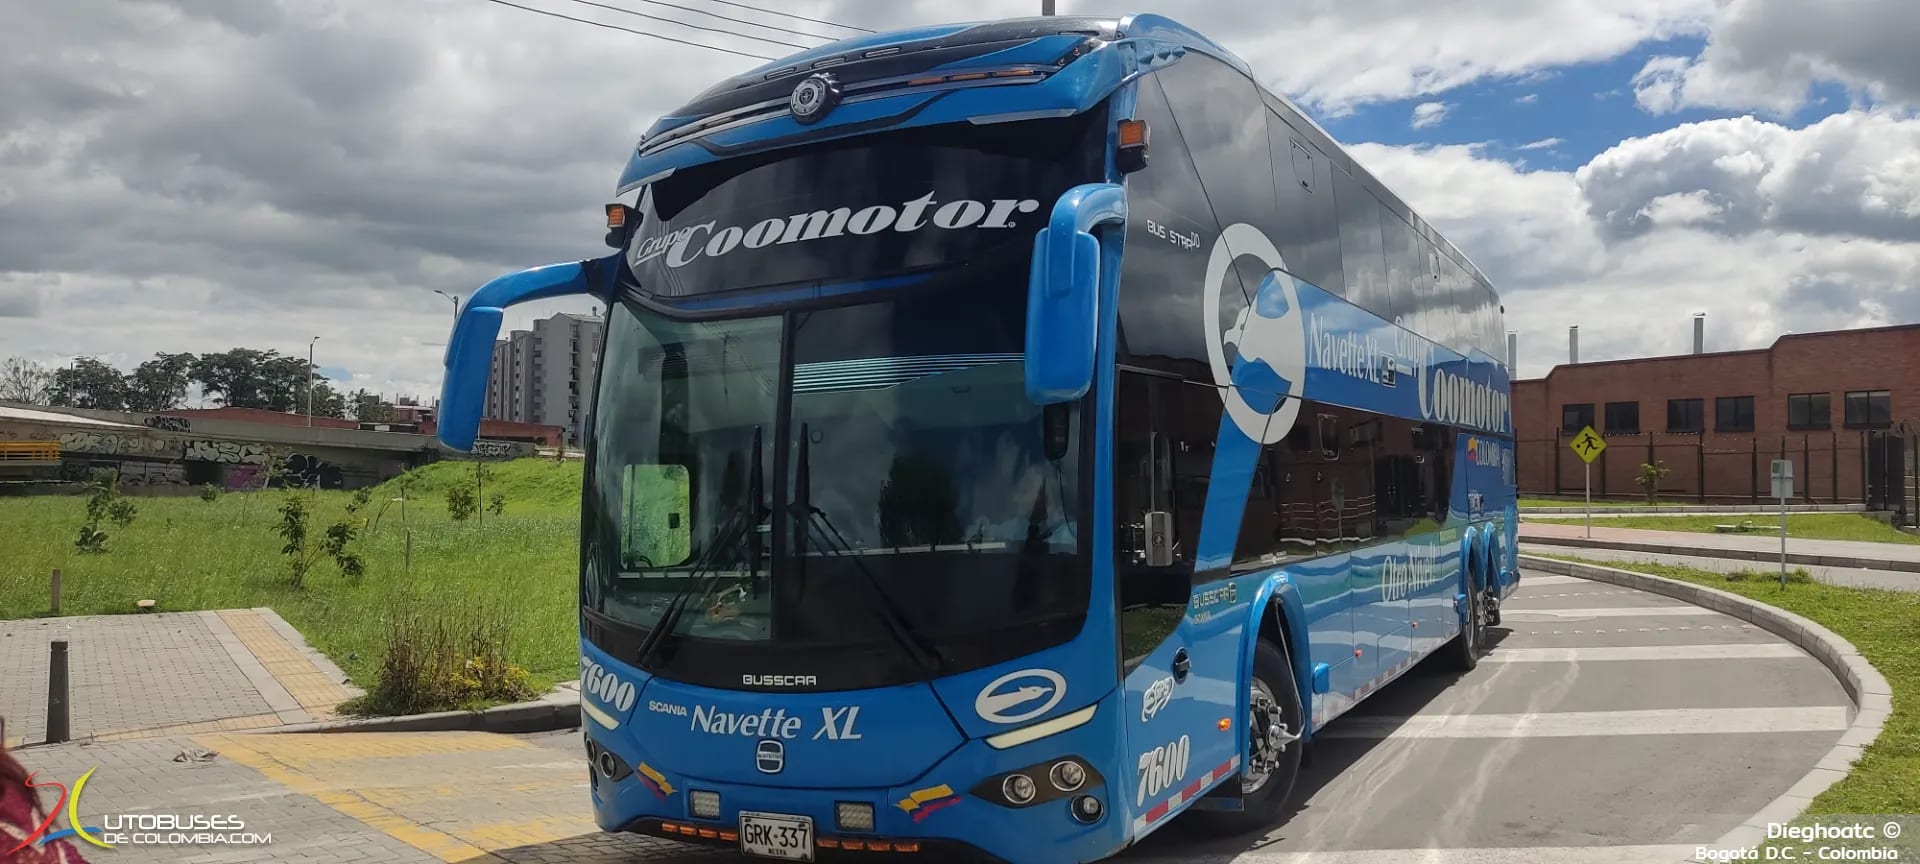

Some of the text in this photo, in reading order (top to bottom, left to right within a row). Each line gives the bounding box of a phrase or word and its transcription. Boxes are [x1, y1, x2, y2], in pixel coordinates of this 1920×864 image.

[634, 227, 691, 267] Grupo
[1147, 219, 1166, 239] BUS
[1309, 312, 1365, 379] Navette
[1418, 340, 1508, 433] Coomotor
[580, 656, 636, 712] 7600
[743, 674, 817, 687] BUSSCAR
[648, 700, 863, 740] SCANIA Navette XL
[1137, 735, 1190, 807] 7600
[744, 823, 808, 849] GRK-337
